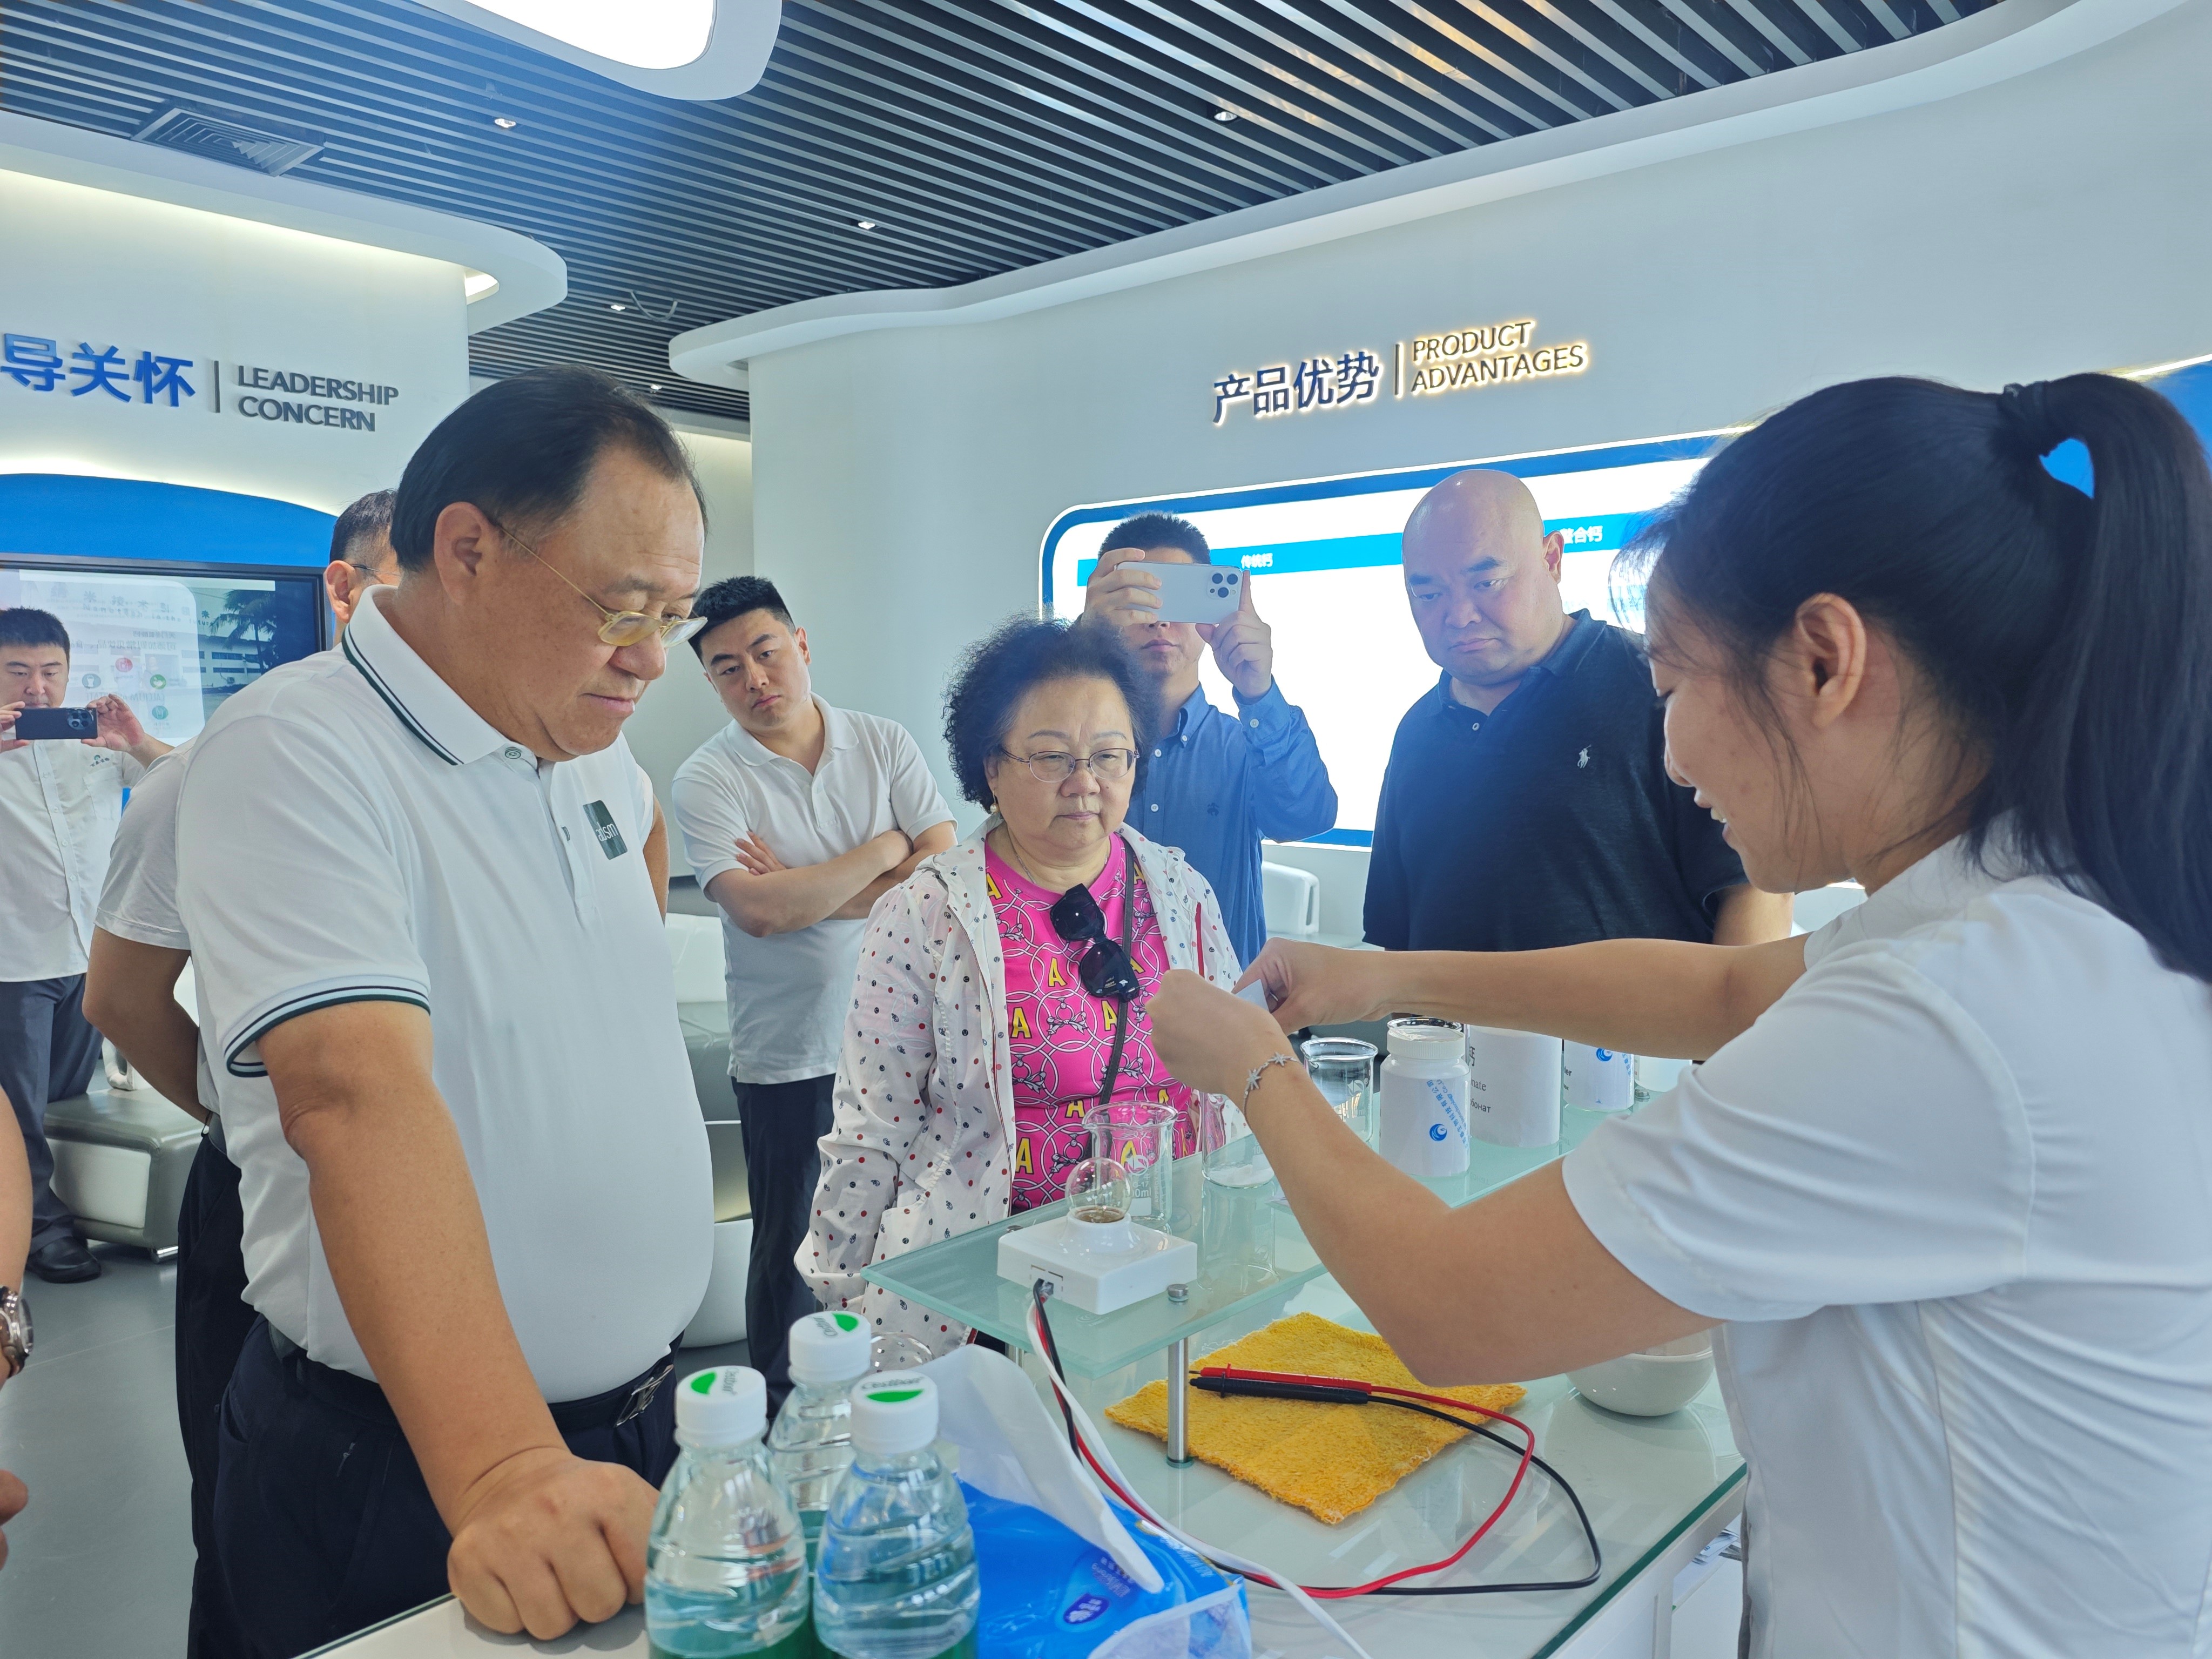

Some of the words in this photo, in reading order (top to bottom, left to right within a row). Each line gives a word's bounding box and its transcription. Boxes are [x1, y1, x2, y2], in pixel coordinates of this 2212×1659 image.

[1413, 321, 1532, 361] PRODUCT
[0, 333, 195, 407] 导关怀
[238, 365, 400, 406] LEADERSHIP
[1212, 351, 1380, 423] 产品优势
[1411, 345, 1584, 392] ADVANTAGES
[238, 396, 376, 432] CONCERN
[1048, 957, 1068, 987] A
[1010, 1006, 1032, 1039] A
[1015, 1137, 1034, 1175] A
